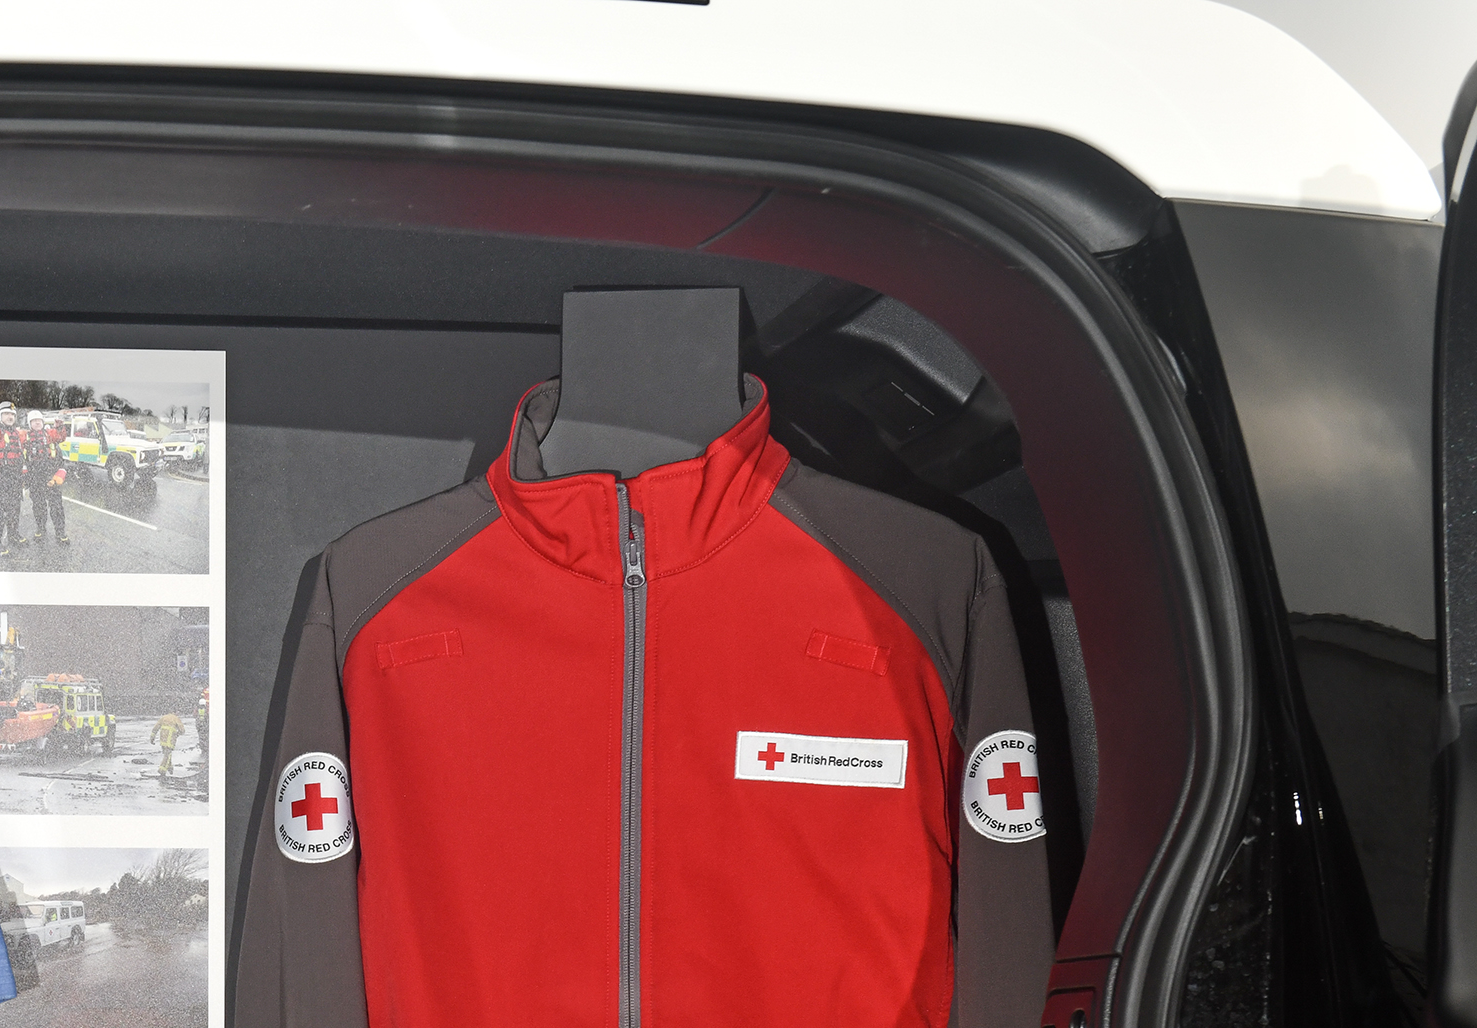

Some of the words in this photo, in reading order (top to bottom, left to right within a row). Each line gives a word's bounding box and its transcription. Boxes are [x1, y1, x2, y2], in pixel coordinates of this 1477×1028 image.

[969, 743, 999, 778] BRITISH
[1001, 740, 1024, 750] RED
[278, 766, 302, 802] BRITISH
[304, 761, 325, 770] RED
[328, 766, 351, 798] CROSS
[970, 800, 1006, 832] BRITISH
[1008, 823, 1033, 833] RED
[279, 824, 305, 853] BRITISH
[308, 843, 331, 853] RED
[333, 821, 352, 848] CROSS
